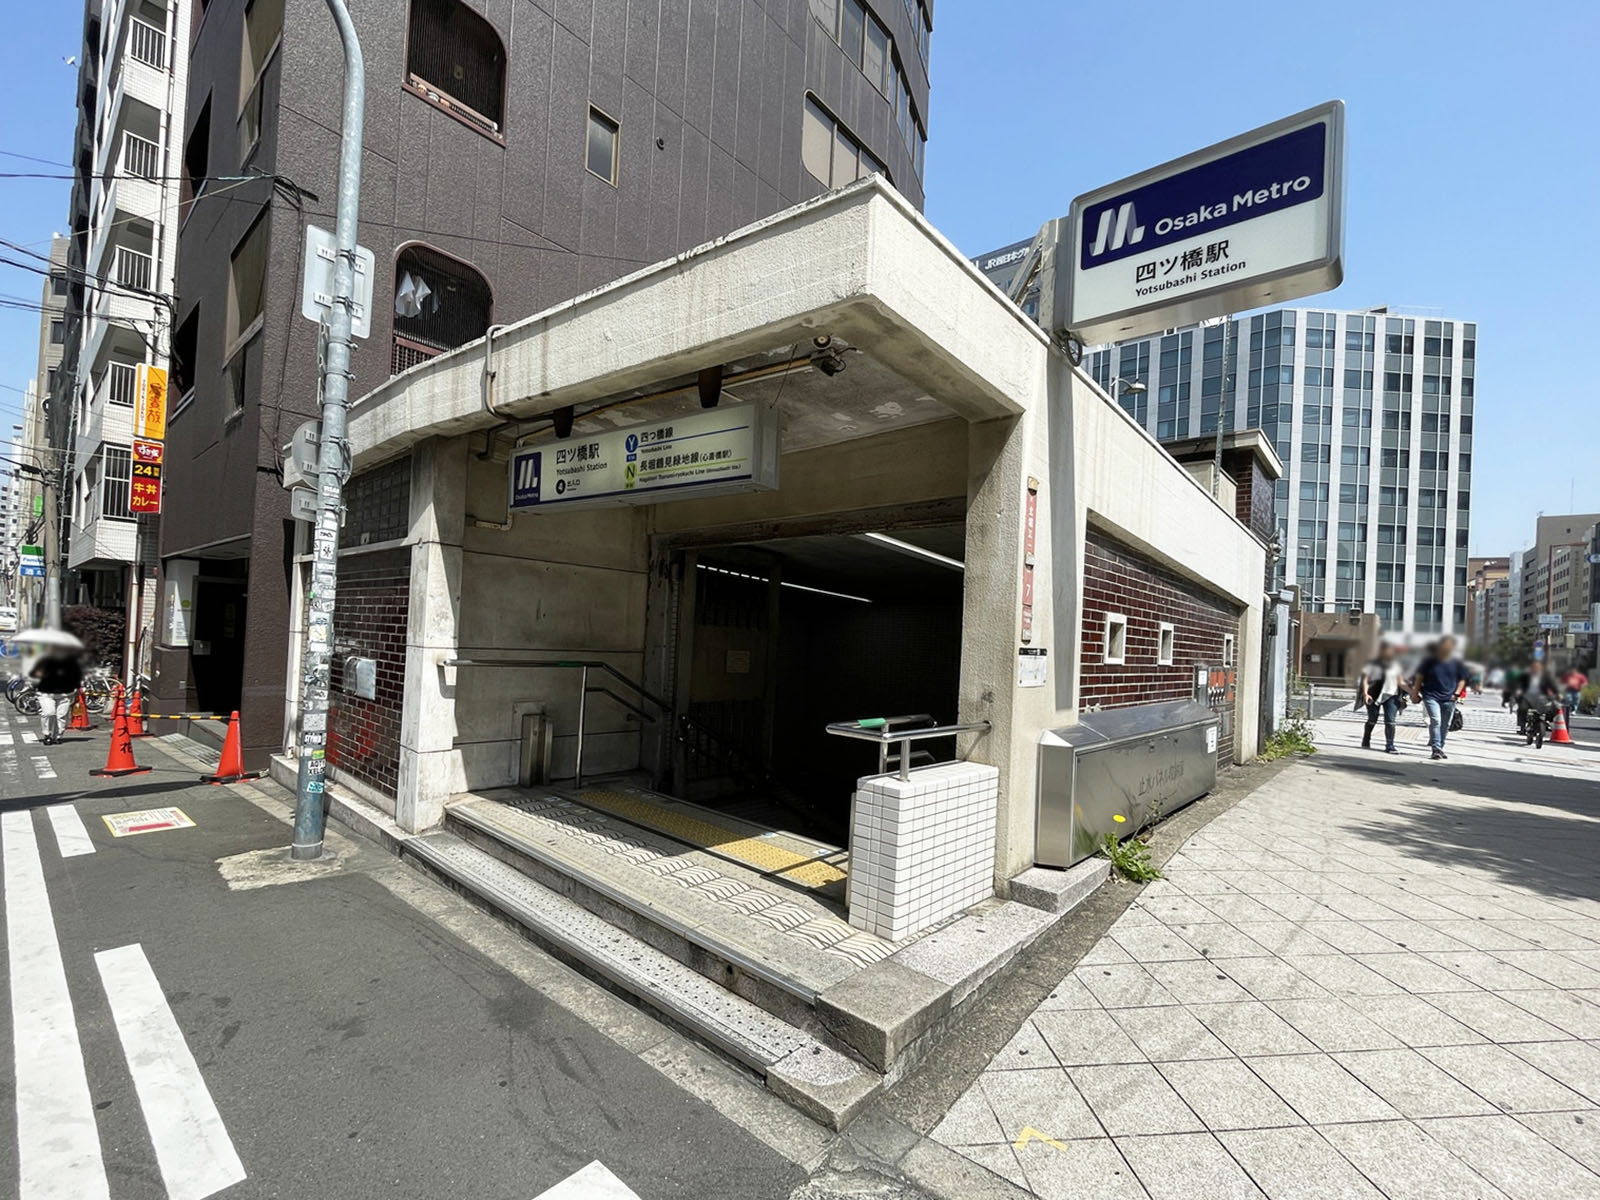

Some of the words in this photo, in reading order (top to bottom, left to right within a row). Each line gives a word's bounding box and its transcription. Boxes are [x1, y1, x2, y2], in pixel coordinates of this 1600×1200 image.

[1154, 202, 1228, 236] Osaka
[1232, 175, 1312, 213] Metro
[1135, 239, 1230, 284] 四ツ橋駅
[1135, 271, 1198, 297] Yotsubashi
[1200, 260, 1247, 281] Station
[640, 427, 674, 443] 四つ橋線
[556, 442, 600, 465] 四ツ橋駅
[586, 462, 608, 471] Station
[626, 464, 635, 479] N
[132, 495, 159, 507] カレー
